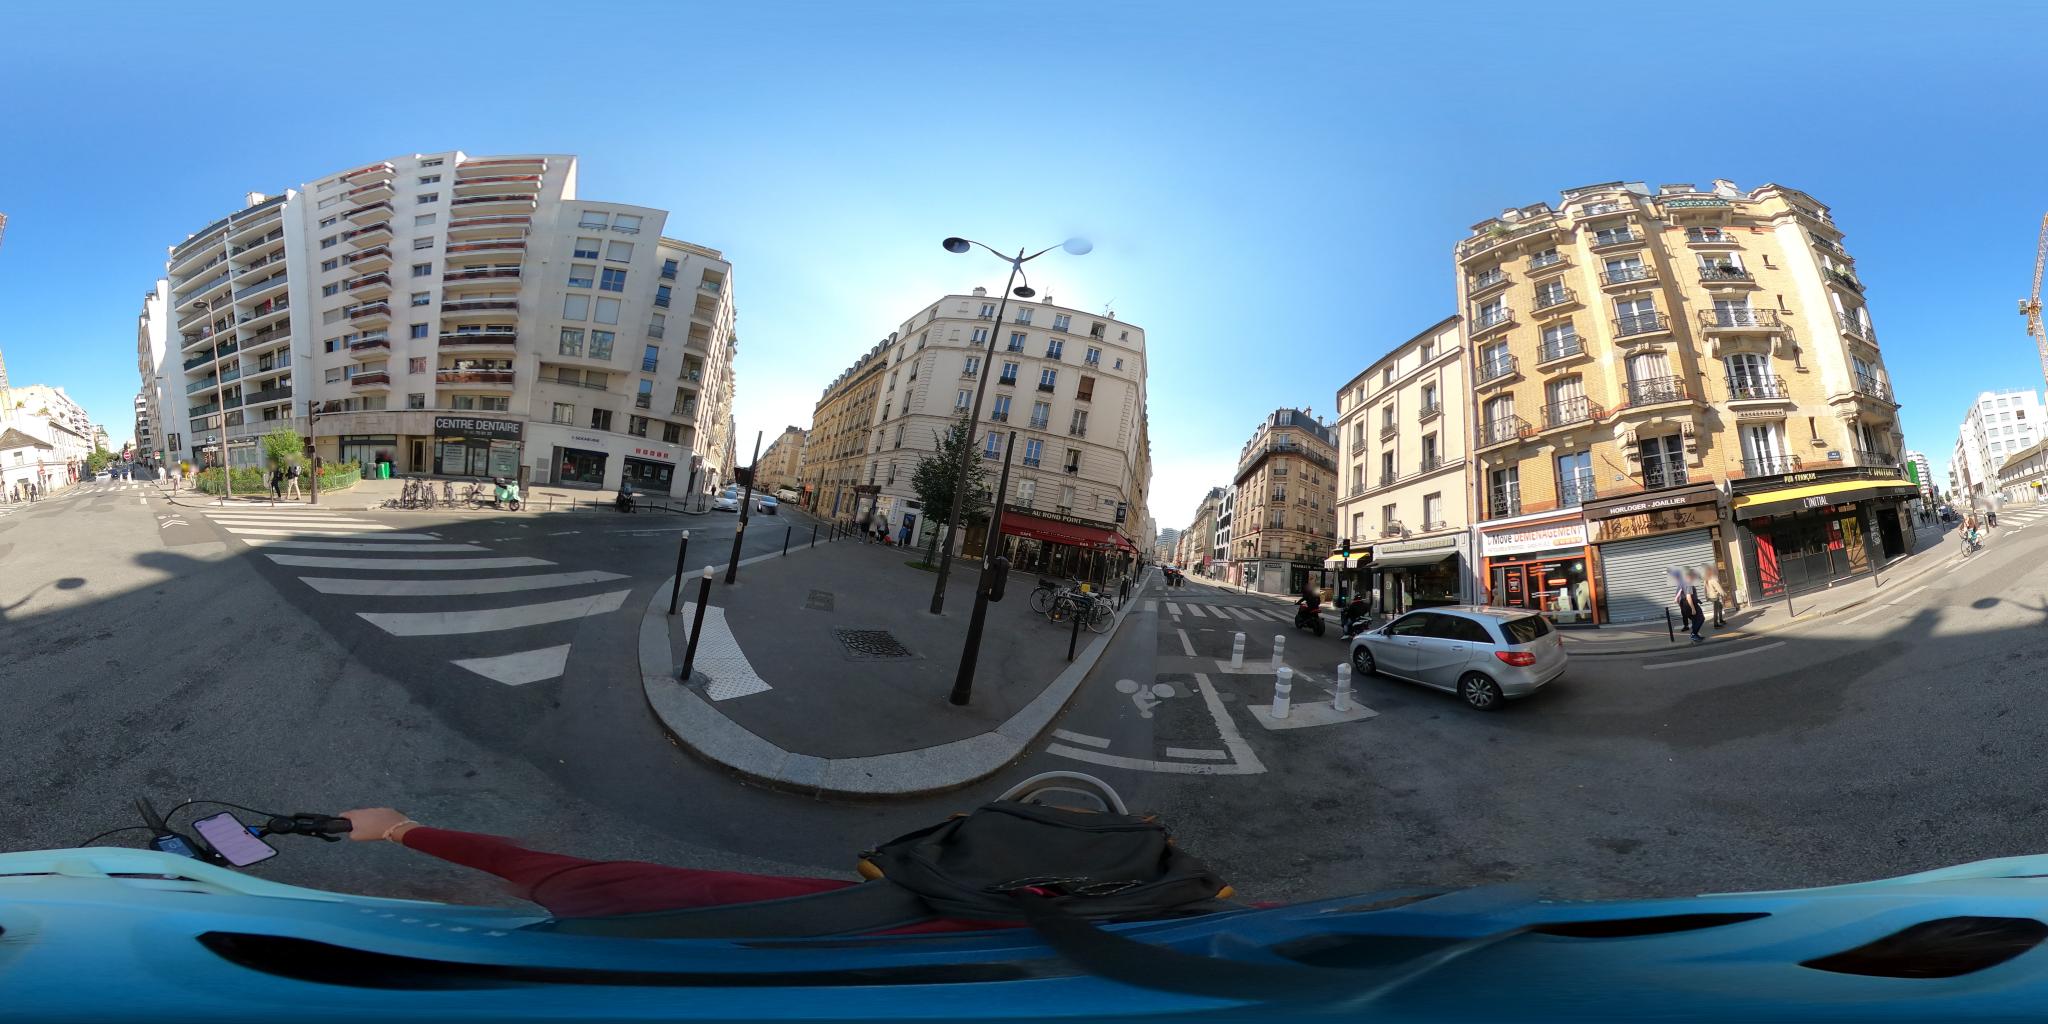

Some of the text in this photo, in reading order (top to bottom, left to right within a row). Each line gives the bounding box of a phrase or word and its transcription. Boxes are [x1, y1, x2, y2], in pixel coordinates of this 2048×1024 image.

[436, 418, 474, 430] CENTRE
[475, 420, 520, 433] DENTAIRE
[1609, 503, 1647, 515] HORLOGER
[1651, 497, 1686, 508] JOAILLIER
[1042, 511, 1061, 521] ROND
[1062, 515, 1082, 525] POINT
